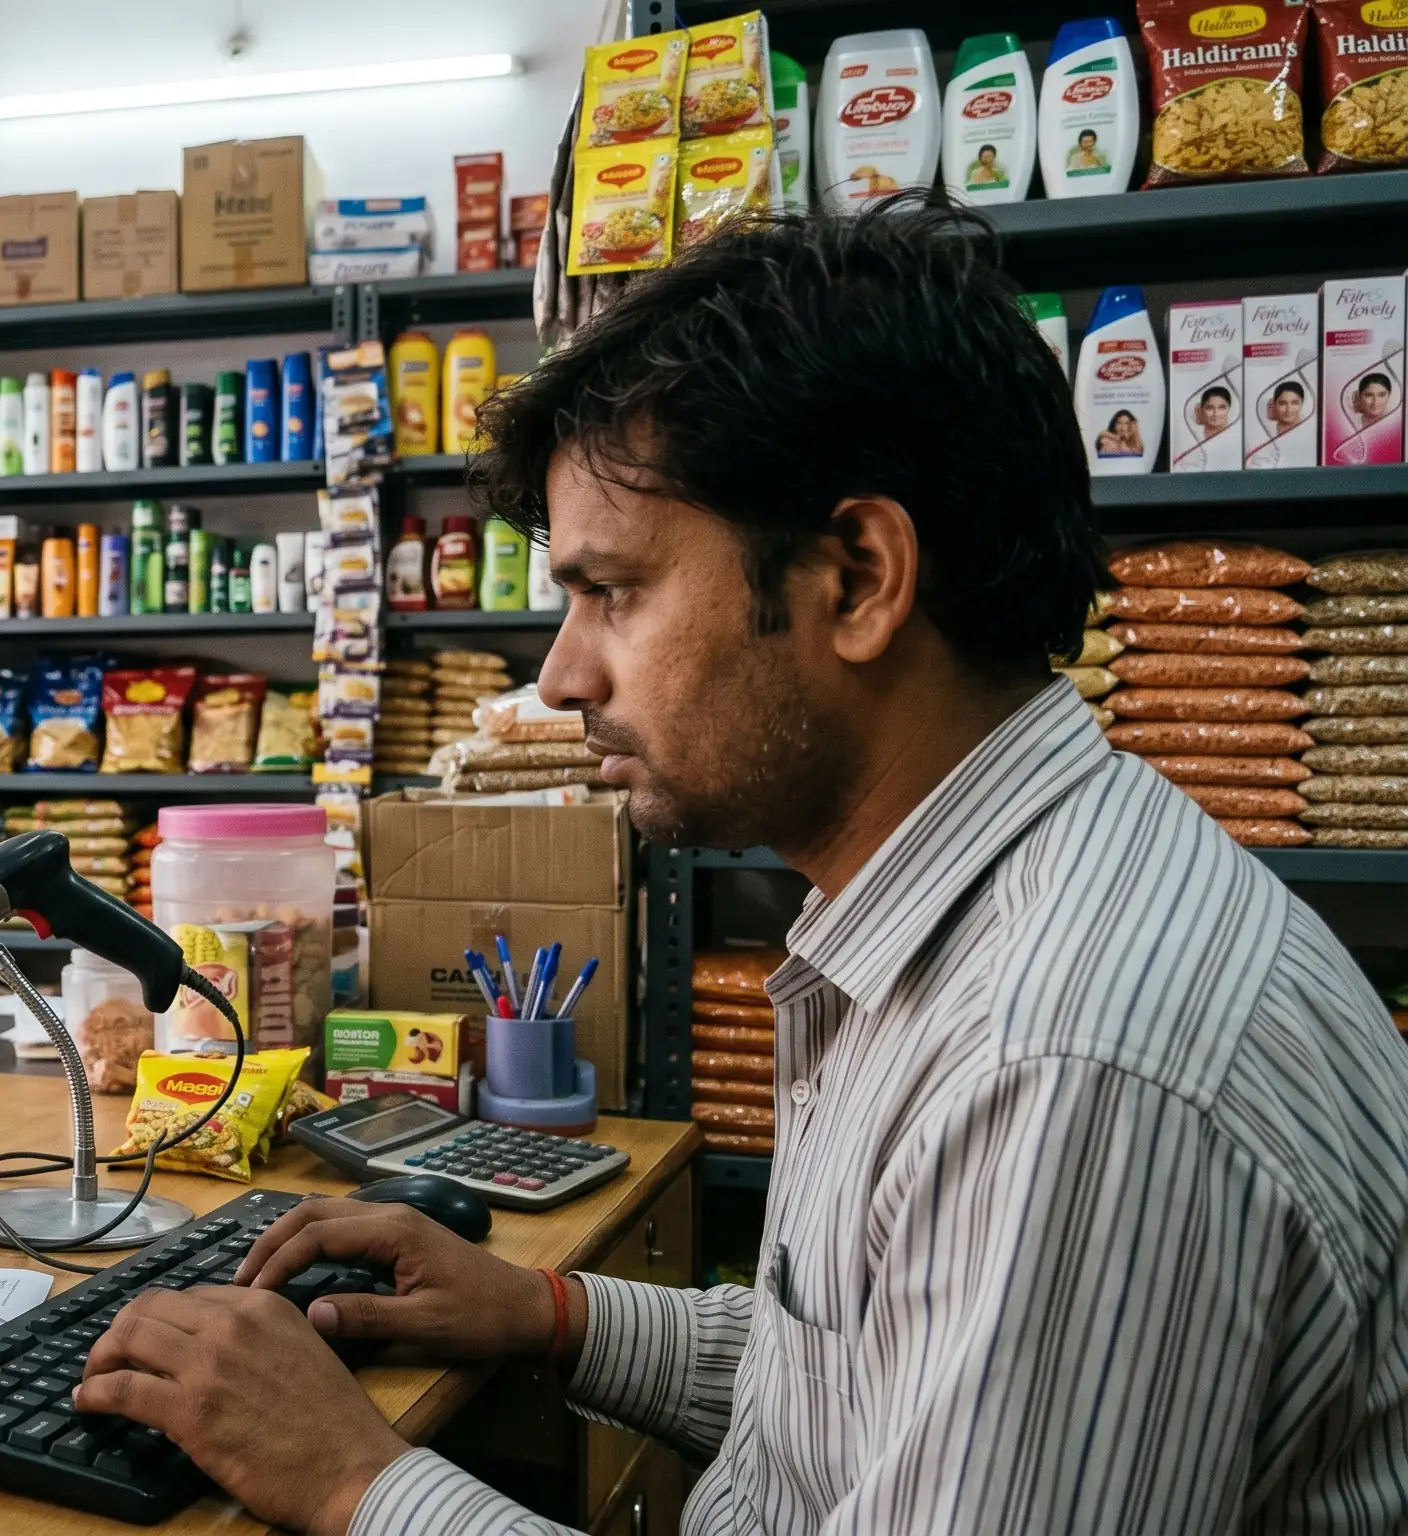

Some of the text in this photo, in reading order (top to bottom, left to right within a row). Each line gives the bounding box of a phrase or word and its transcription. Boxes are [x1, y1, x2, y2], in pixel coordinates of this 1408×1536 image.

[1162, 40, 1298, 70] Haldiram's
[1347, 299, 1396, 321] Lovely
[1190, 325, 1236, 343] Lovely
[1263, 316, 1310, 337] Lovely
[166, 1079, 225, 1096] Maggi
